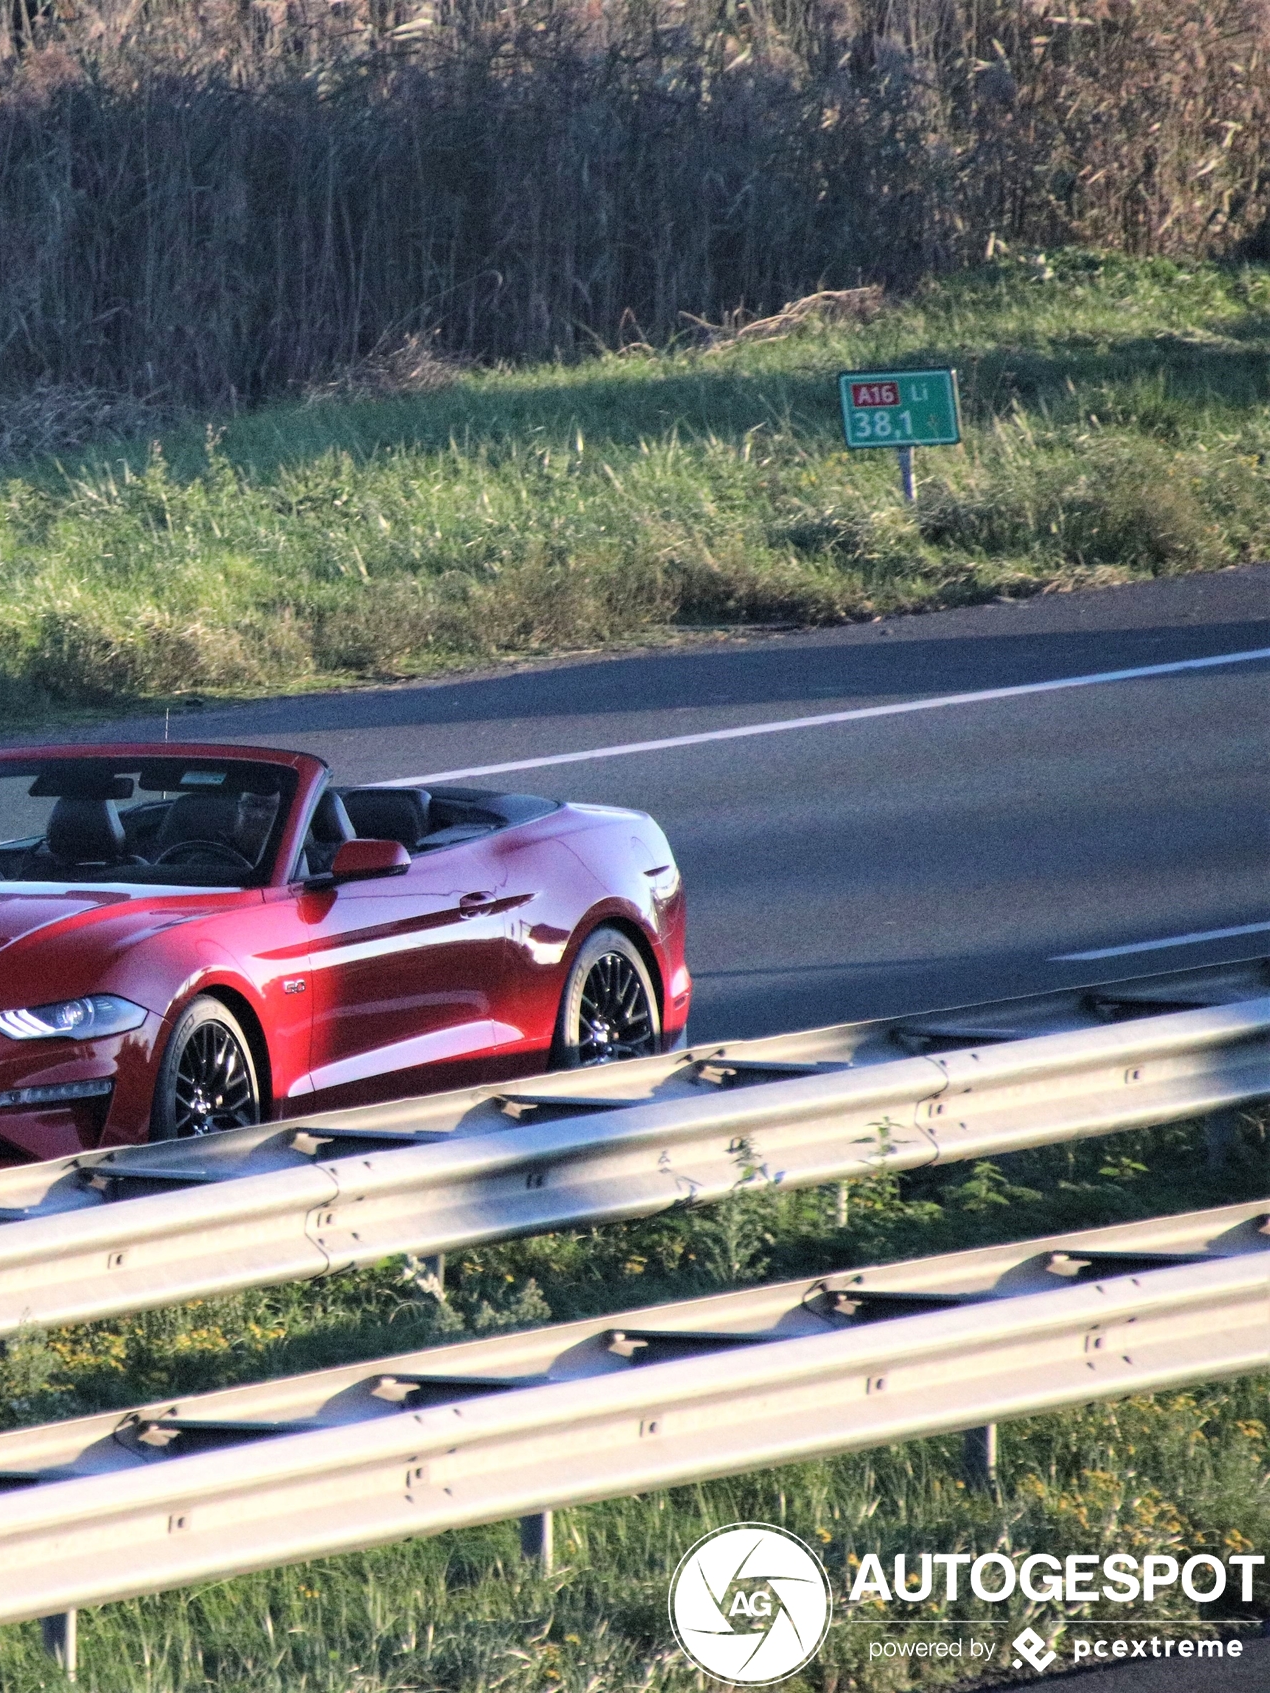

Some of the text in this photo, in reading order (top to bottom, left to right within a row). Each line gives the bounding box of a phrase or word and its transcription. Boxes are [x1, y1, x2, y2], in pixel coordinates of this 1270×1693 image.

[857, 383, 929, 404] A16 Li
[854, 410, 913, 440] 38,1
